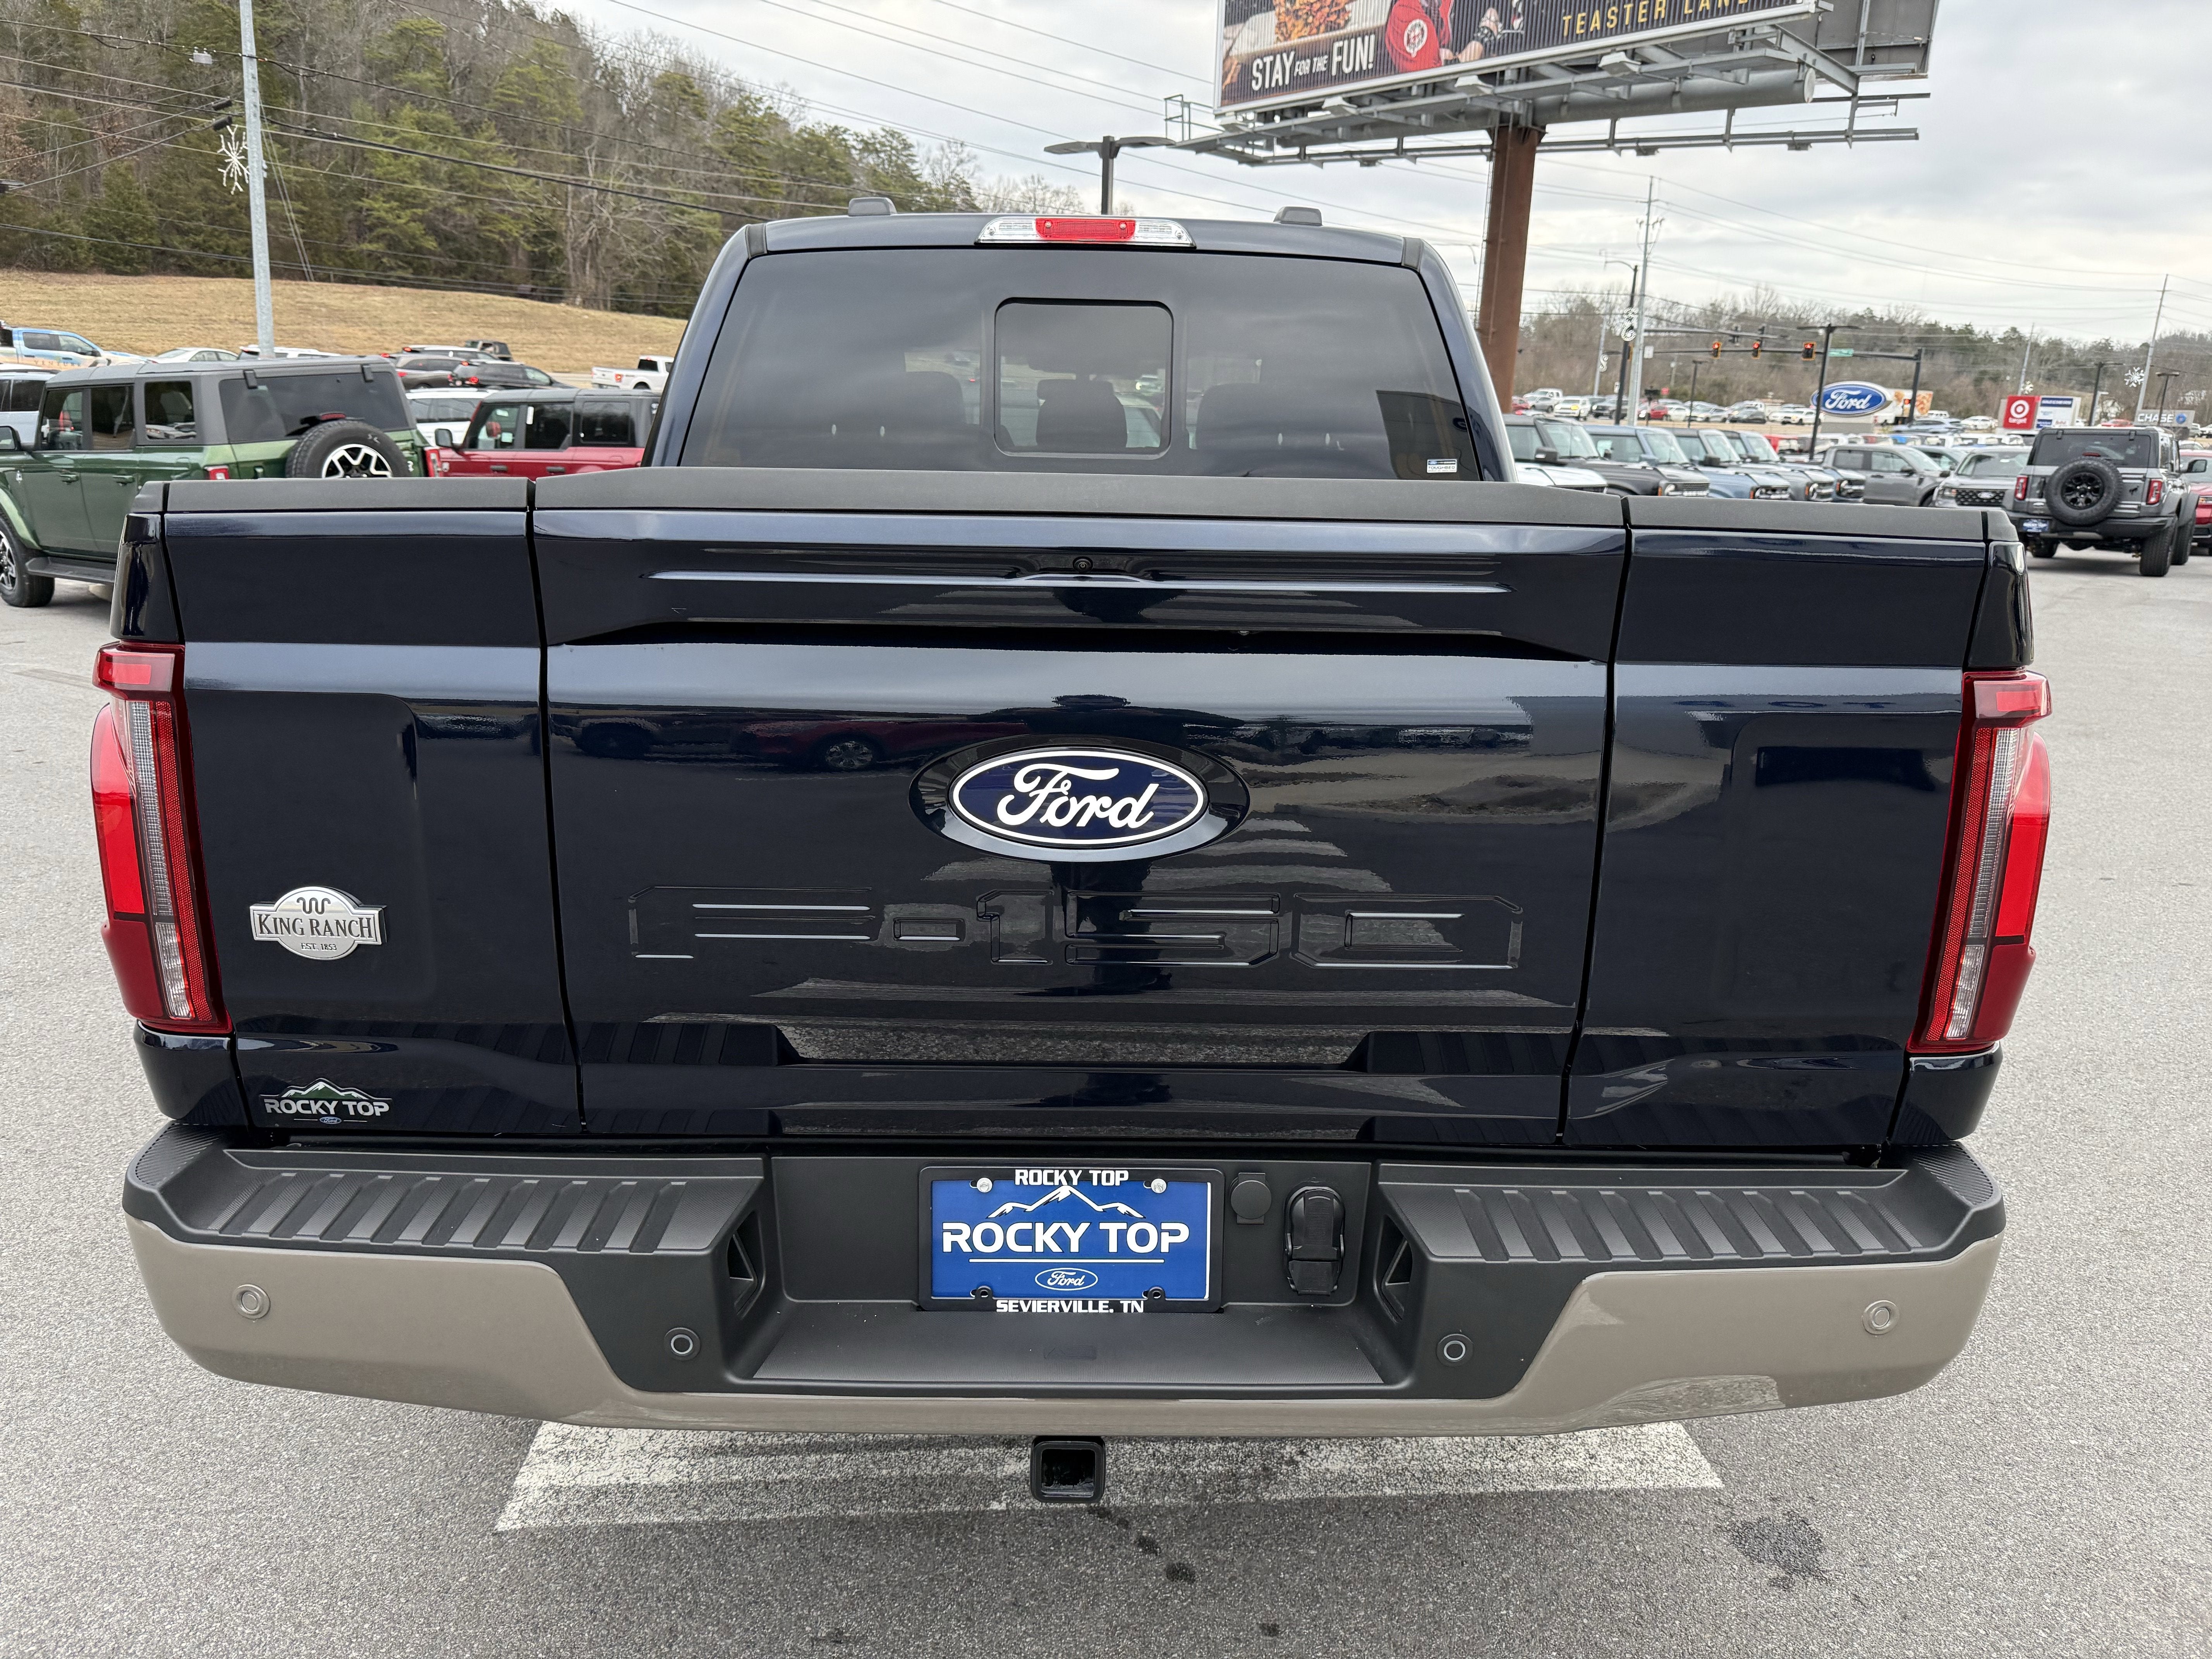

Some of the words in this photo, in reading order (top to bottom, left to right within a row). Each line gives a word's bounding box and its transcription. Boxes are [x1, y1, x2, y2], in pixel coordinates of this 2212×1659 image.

[1562, 0, 1666, 36] TEASTER
[1252, 51, 1295, 91] STAY
[1294, 59, 1310, 77] FOR
[1312, 55, 1329, 73] THE
[1331, 34, 1375, 76] FUN!
[1825, 389, 1872, 409] Ford
[2137, 413, 2174, 423] CHASE
[997, 763, 1159, 828] Ford
[257, 914, 305, 936] KING
[309, 917, 374, 938] RANCH
[628, 886, 1523, 969] F-150
[264, 1099, 338, 1115] ROCKY
[342, 1101, 390, 1116] TOP
[1015, 1169, 1082, 1186] ROCKY
[1089, 1170, 1129, 1186] TOP
[943, 1222, 1091, 1253] ROCKY
[1099, 1222, 1190, 1253] TOP
[1047, 1271, 1086, 1286] Ford
[1120, 1300, 1144, 1313] TN
